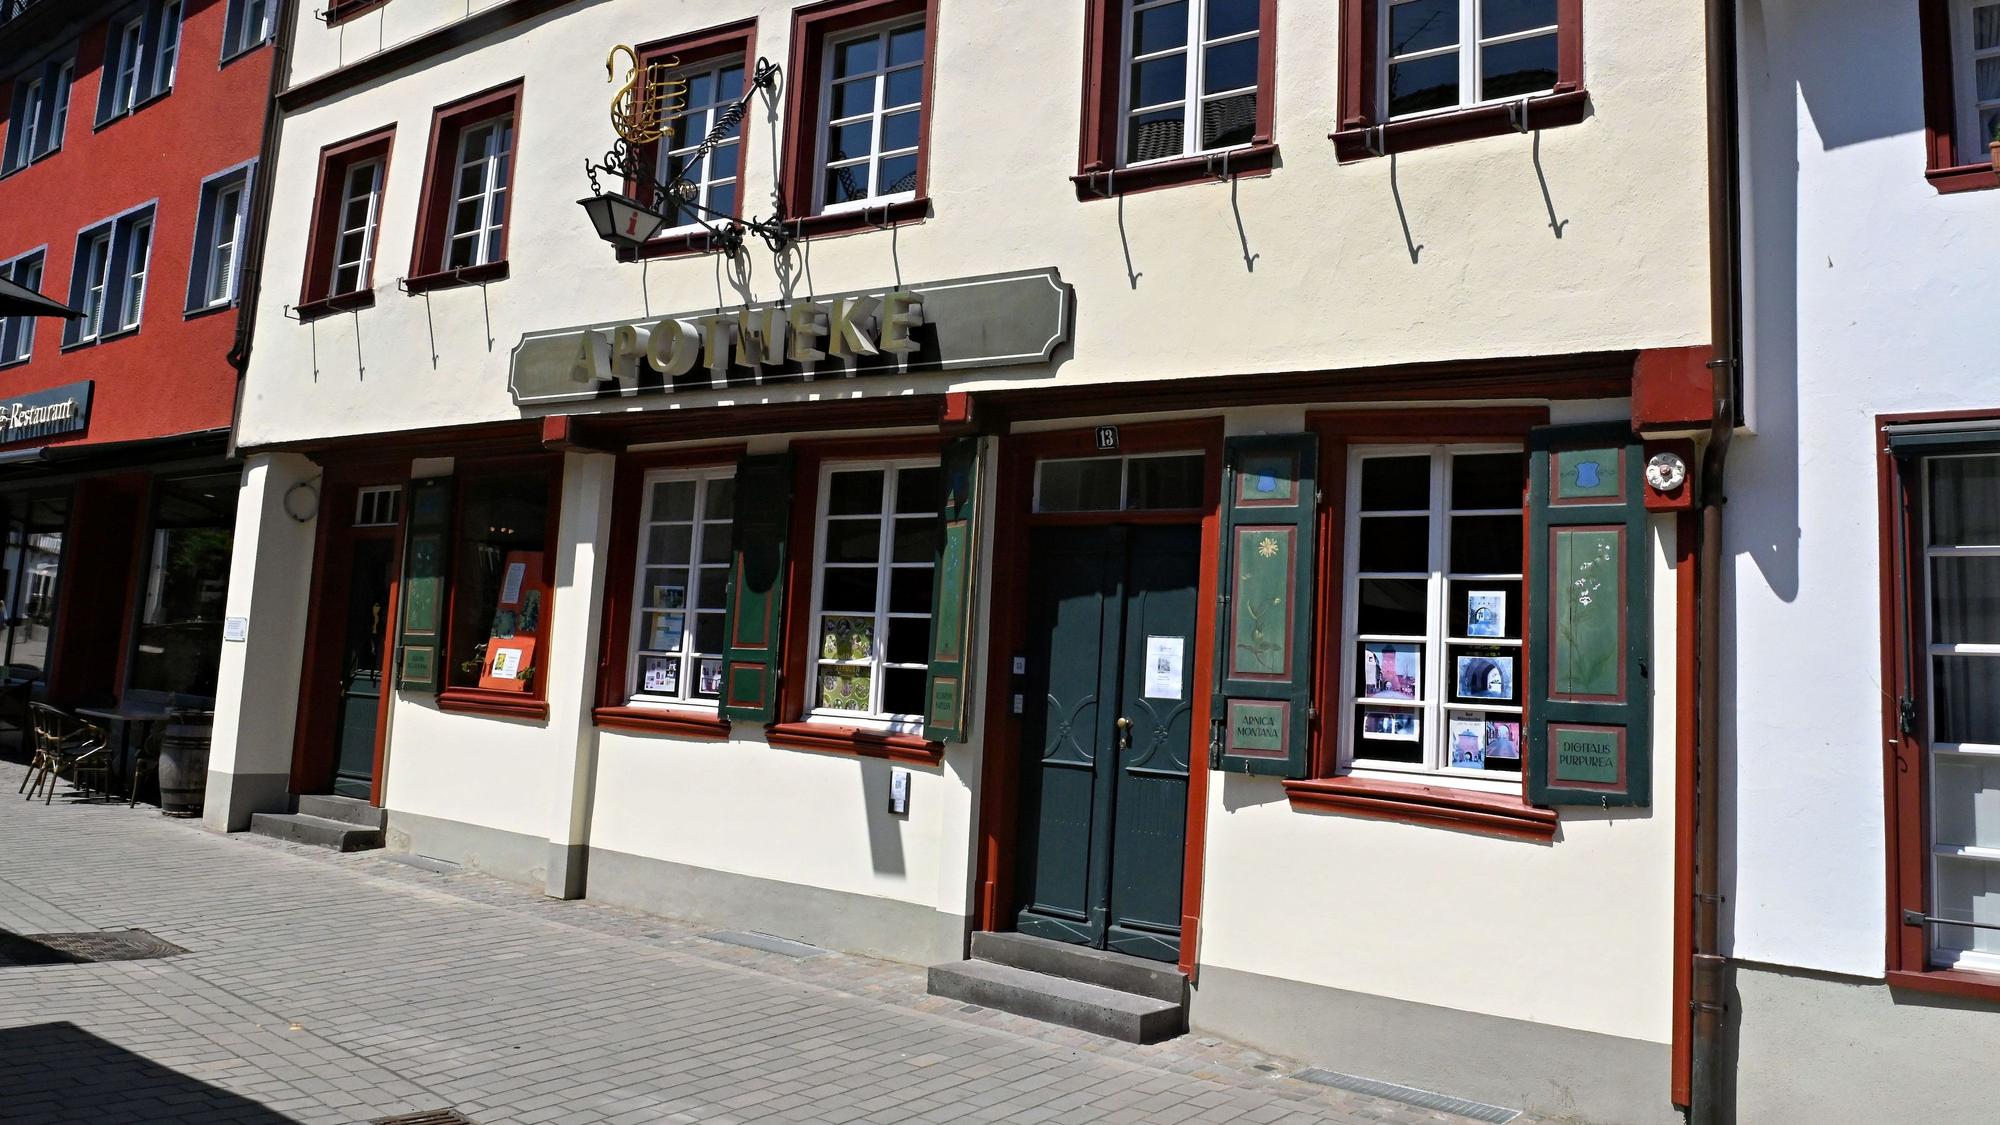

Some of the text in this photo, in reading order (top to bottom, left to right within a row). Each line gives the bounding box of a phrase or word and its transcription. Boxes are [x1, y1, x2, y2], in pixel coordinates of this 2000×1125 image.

[626, 211, 638, 235] i
[571, 291, 924, 384] APOTHEKE
[1100, 429, 1113, 446] 13
[1242, 715, 1274, 726] ARNICA
[1236, 727, 1278, 737] MONTANA
[1563, 742, 1611, 754] DIGITALIS
[1560, 755, 1614, 768] PURPUREA
